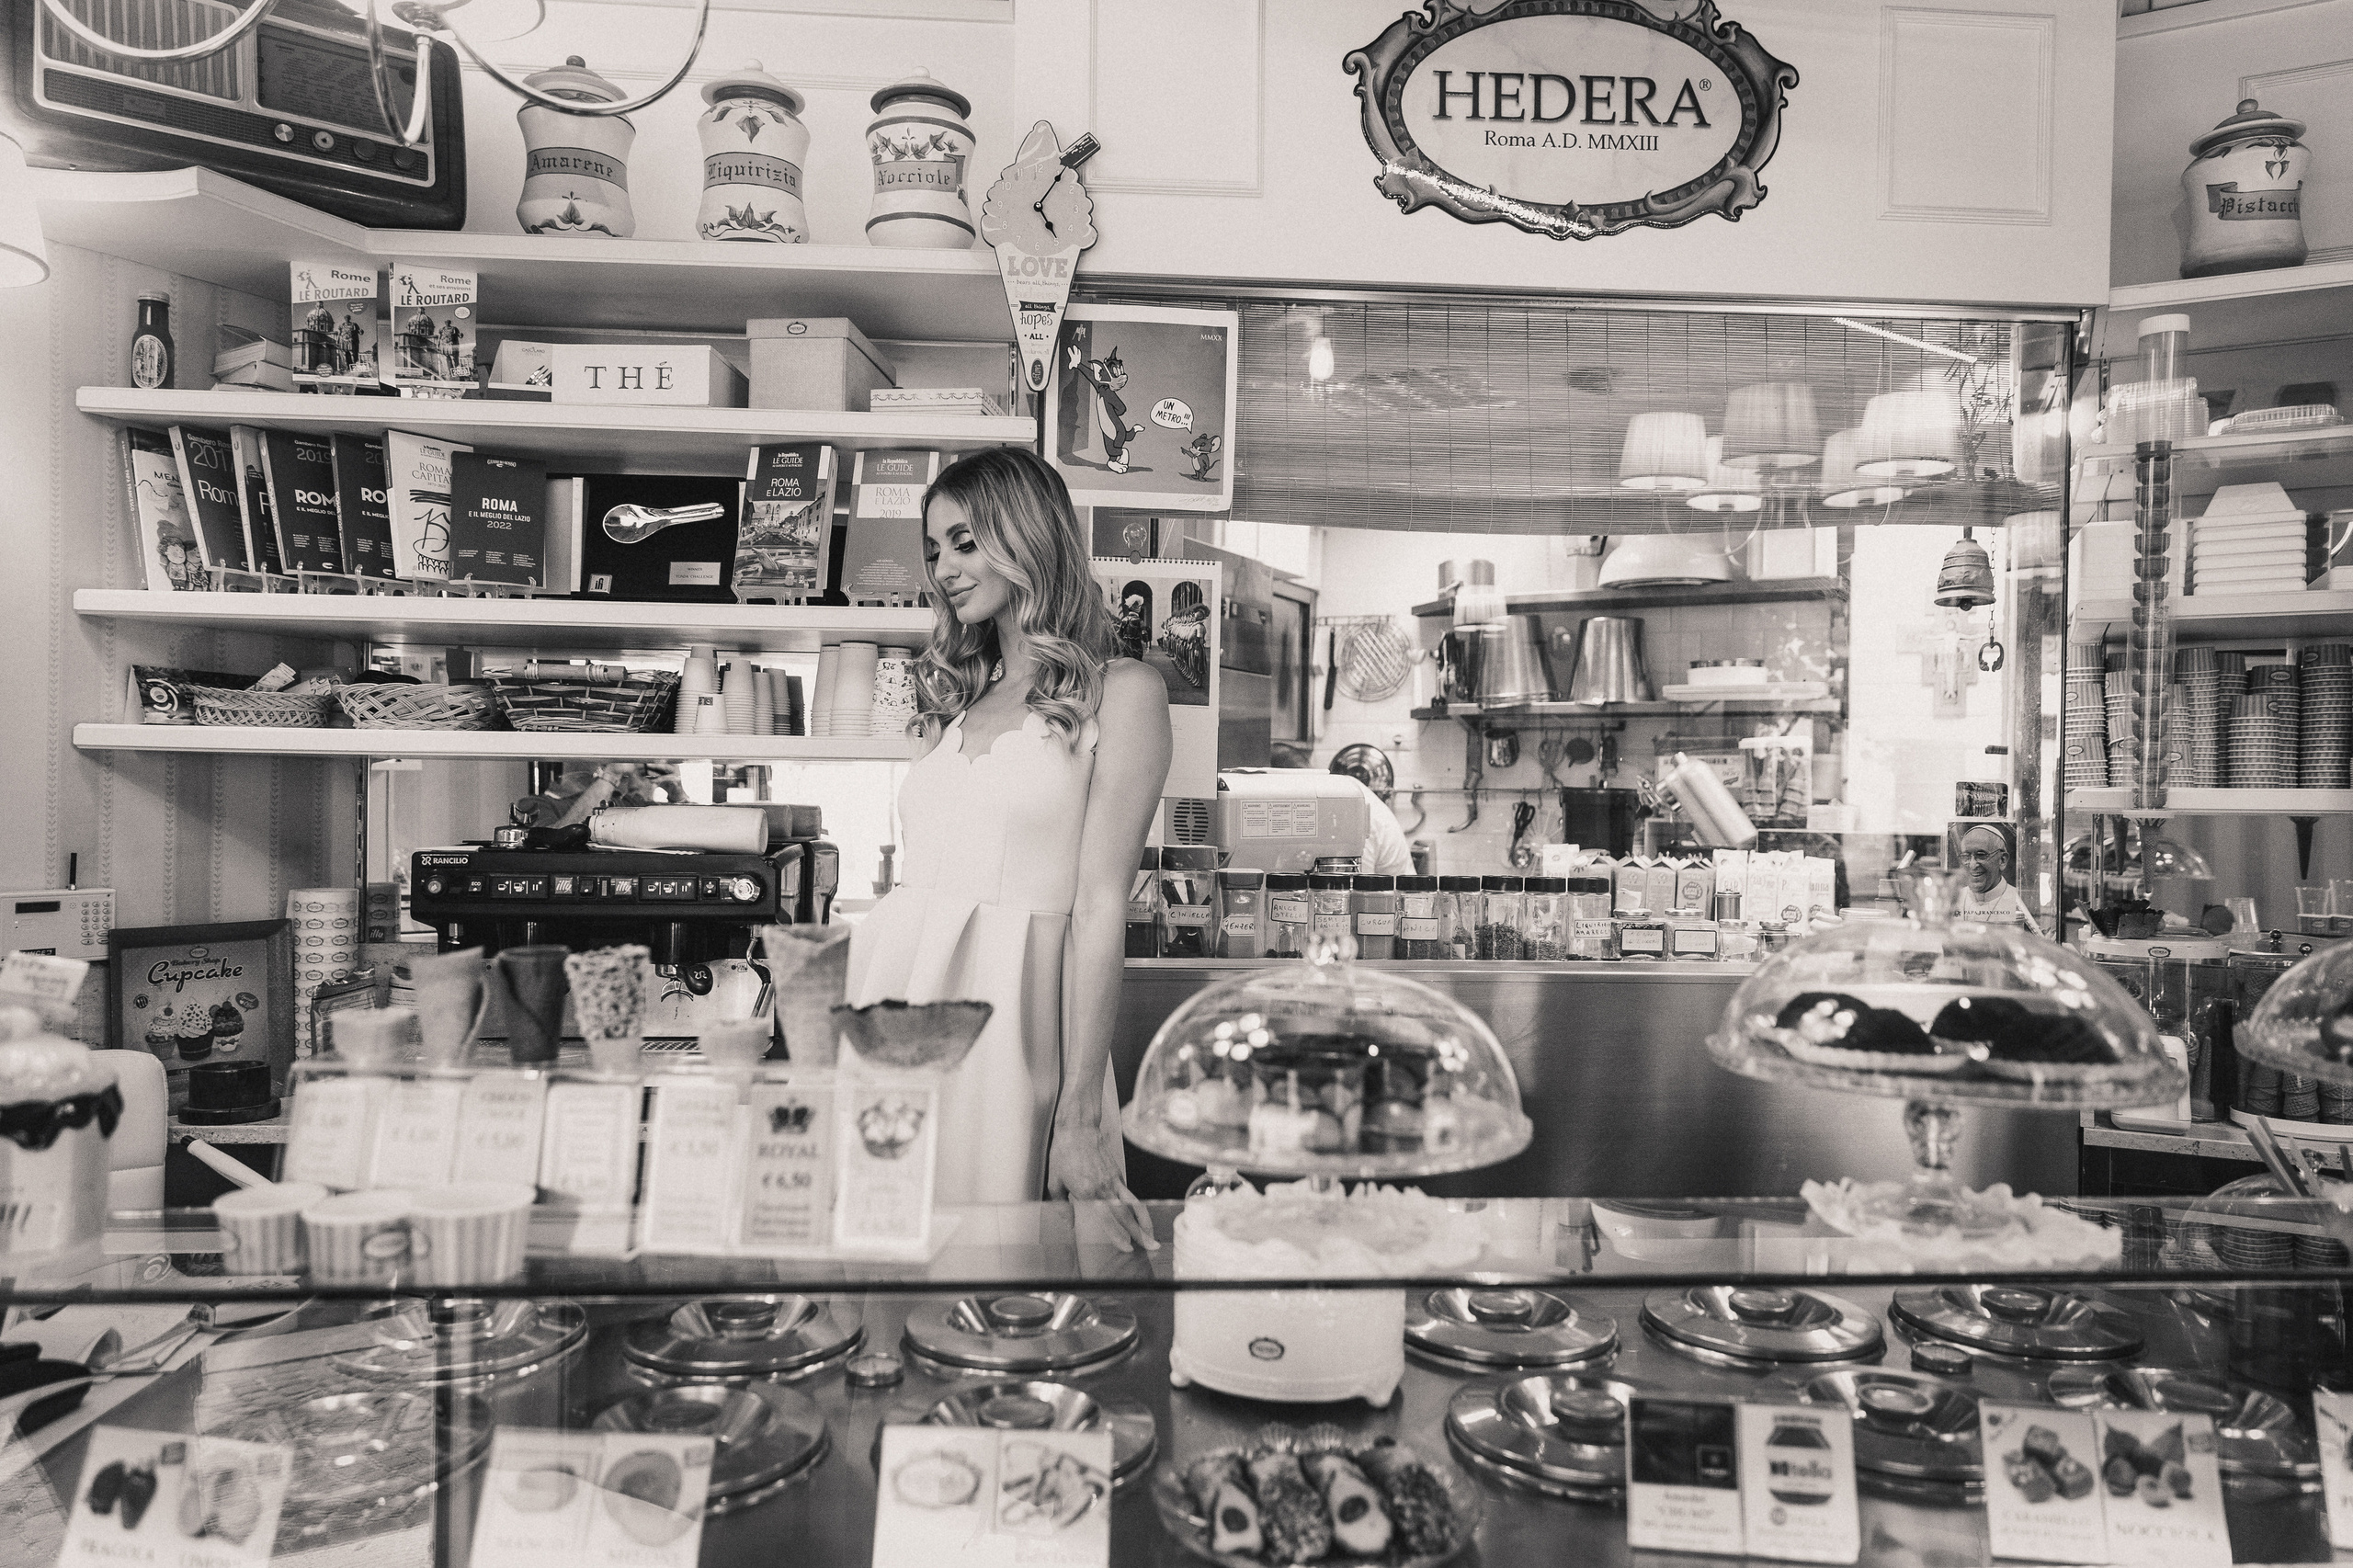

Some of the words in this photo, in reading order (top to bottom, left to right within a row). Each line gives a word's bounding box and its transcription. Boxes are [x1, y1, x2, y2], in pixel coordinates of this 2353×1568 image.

[1484, 131, 1536, 148] Roma
[1543, 132, 1581, 149] A.D.
[1587, 133, 1659, 151] MMXIII
[530, 154, 613, 177] Amarene
[708, 161, 797, 187] Liquirizia
[878, 168, 948, 187] Nocciole
[1007, 256, 1068, 278] LOVE
[331, 270, 371, 283] Rome
[440, 275, 472, 285] Rome
[299, 290, 311, 301] LE
[314, 288, 369, 300] ROUTARD
[401, 295, 412, 306] LE
[415, 293, 470, 305] ROUTARD
[1020, 312, 1053, 330] hopes
[1200, 334, 1223, 342] MMXX
[585, 361, 674, 390] THÉ
[1163, 400, 1176, 411] UN
[187, 433, 217, 447] Gambero
[419, 462, 452, 476] ROMA
[771, 478, 800, 487] ROMA
[198, 479, 239, 506] Rom
[772, 487, 801, 497] LAZIO
[876, 486, 910, 497] ROMA
[482, 497, 517, 513] ROMA
[881, 497, 911, 506] LAZIO
[503, 513, 513, 521] DEL
[514, 515, 531, 523] LAZIO
[880, 508, 902, 519] 2019
[486, 520, 513, 530] 2022
[433, 856, 469, 865] RANCILIO
[556, 878, 573, 892] illy
[615, 879, 632, 893] illy
[369, 929, 384, 938] illy
[1403, 924, 1437, 933] ANICE
[170, 959, 200, 967] Bakery
[202, 958, 222, 966] Shop
[147, 957, 244, 993] Cupcake
[757, 1143, 819, 1158] ROYAL
[762, 1172, 772, 1188] €
[776, 1172, 813, 1189] 6,50
